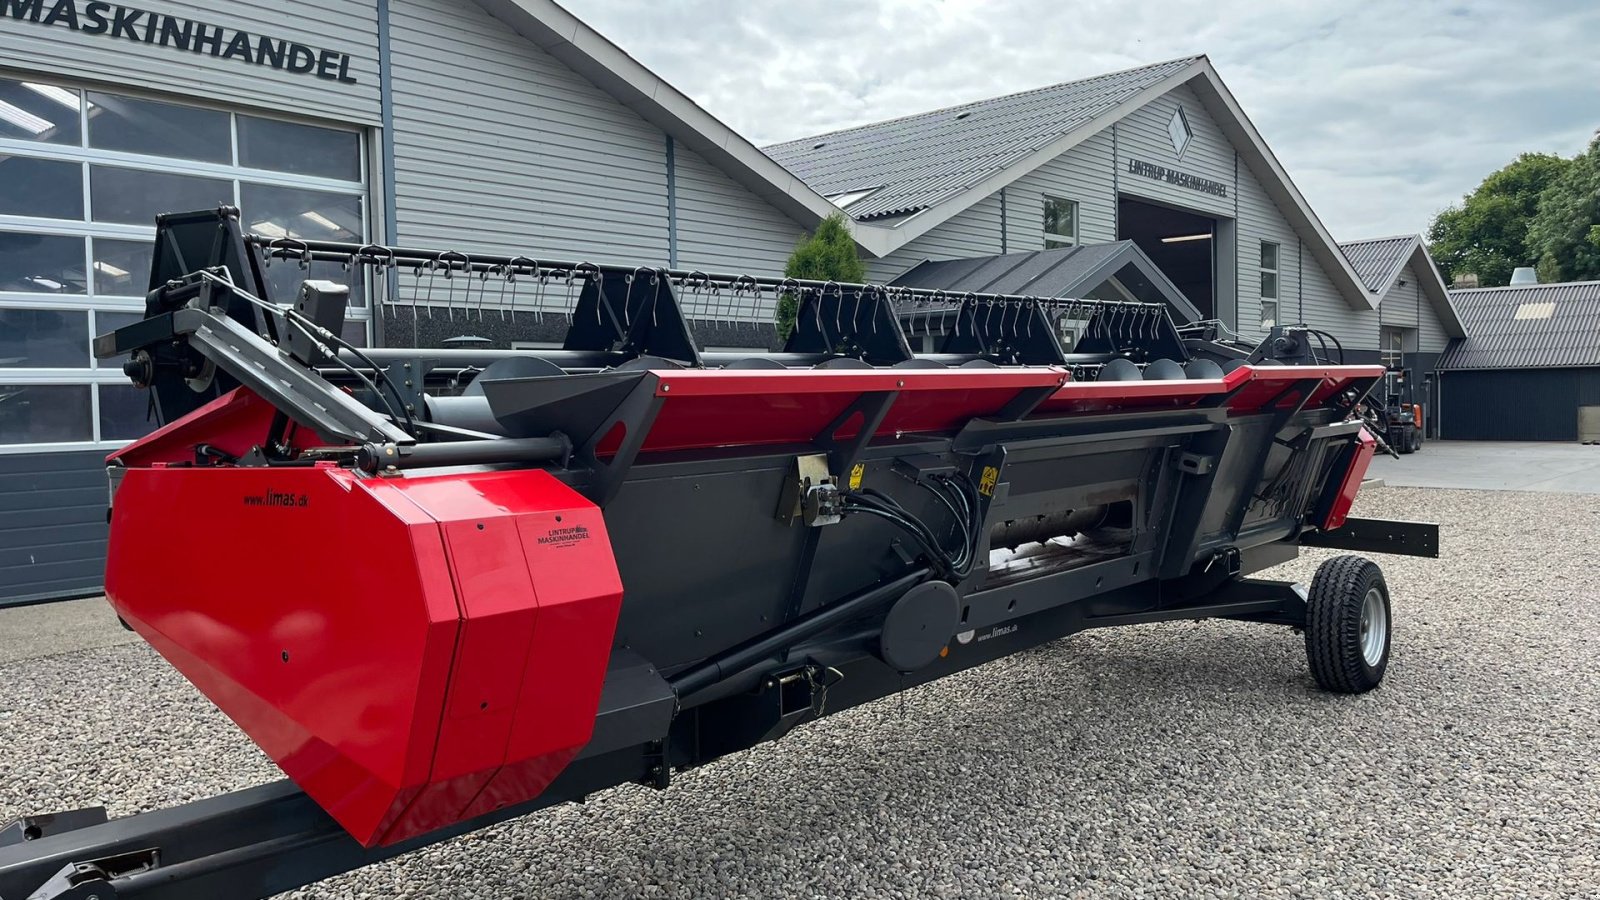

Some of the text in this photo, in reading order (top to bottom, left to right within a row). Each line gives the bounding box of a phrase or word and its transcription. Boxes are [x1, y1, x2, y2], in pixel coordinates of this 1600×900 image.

[0, 0, 357, 84] MASKINHANDEL
[1129, 158, 1227, 198] LINTRUP MASKINHANDEL
[243, 488, 308, 507] www.limas.dk
[538, 532, 590, 544] MASKINHANDEL
[548, 527, 576, 536] LINTRUP
